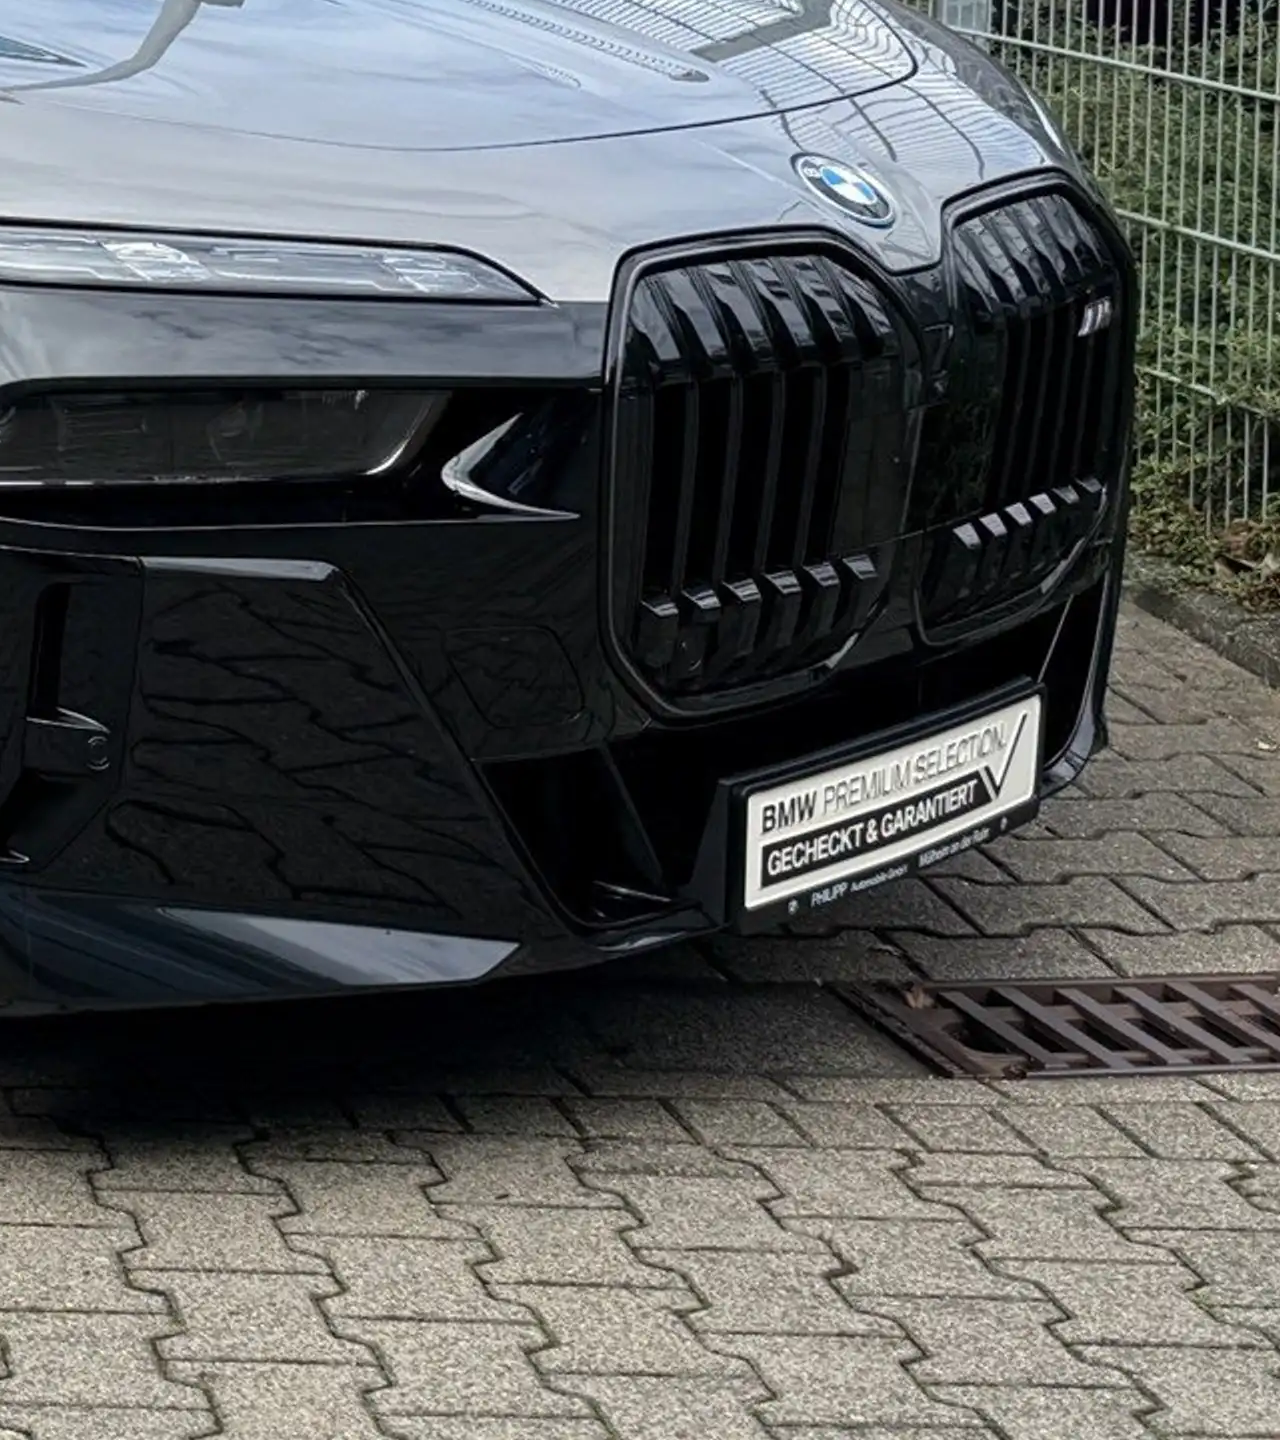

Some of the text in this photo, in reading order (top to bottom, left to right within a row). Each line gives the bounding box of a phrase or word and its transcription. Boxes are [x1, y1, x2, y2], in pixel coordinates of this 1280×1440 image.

[762, 723, 1007, 834] BMW PREMIUM SELECTION.
[767, 820, 865, 876] GECHECKT
[865, 819, 879, 844] &
[880, 779, 978, 836] GARANTIERT
